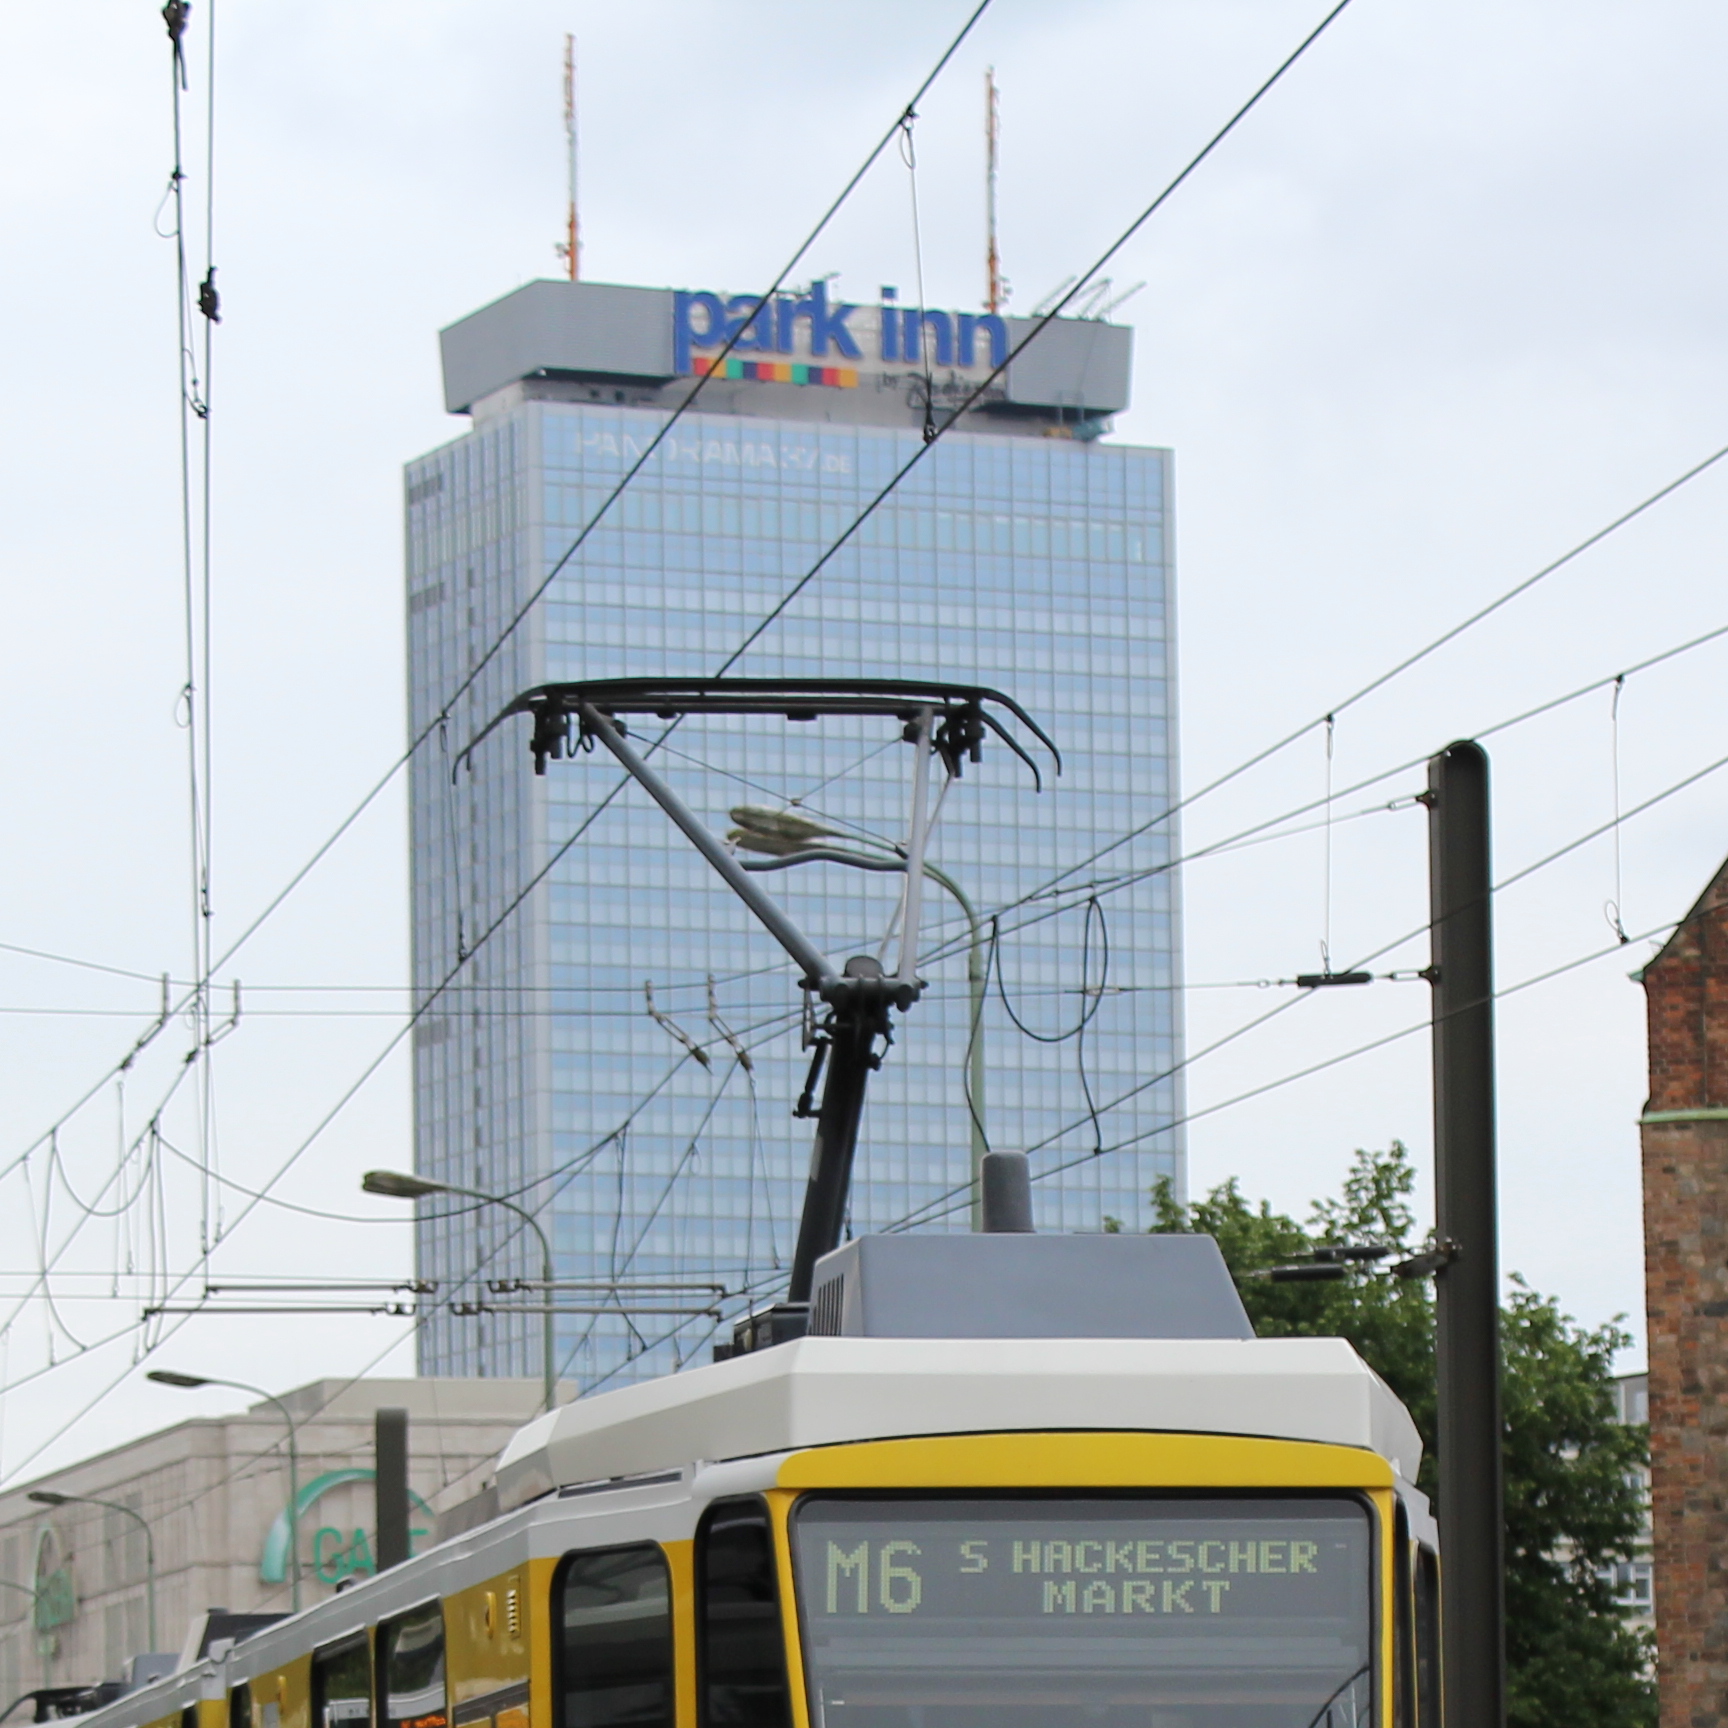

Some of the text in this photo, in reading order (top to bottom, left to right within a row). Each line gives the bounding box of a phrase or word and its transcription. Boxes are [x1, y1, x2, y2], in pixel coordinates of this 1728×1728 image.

[674, 280, 1009, 374] park inn
[826, 1540, 1318, 1615] M6 S HACKESCHER
[1042, 1580, 1230, 1614] MARKT
